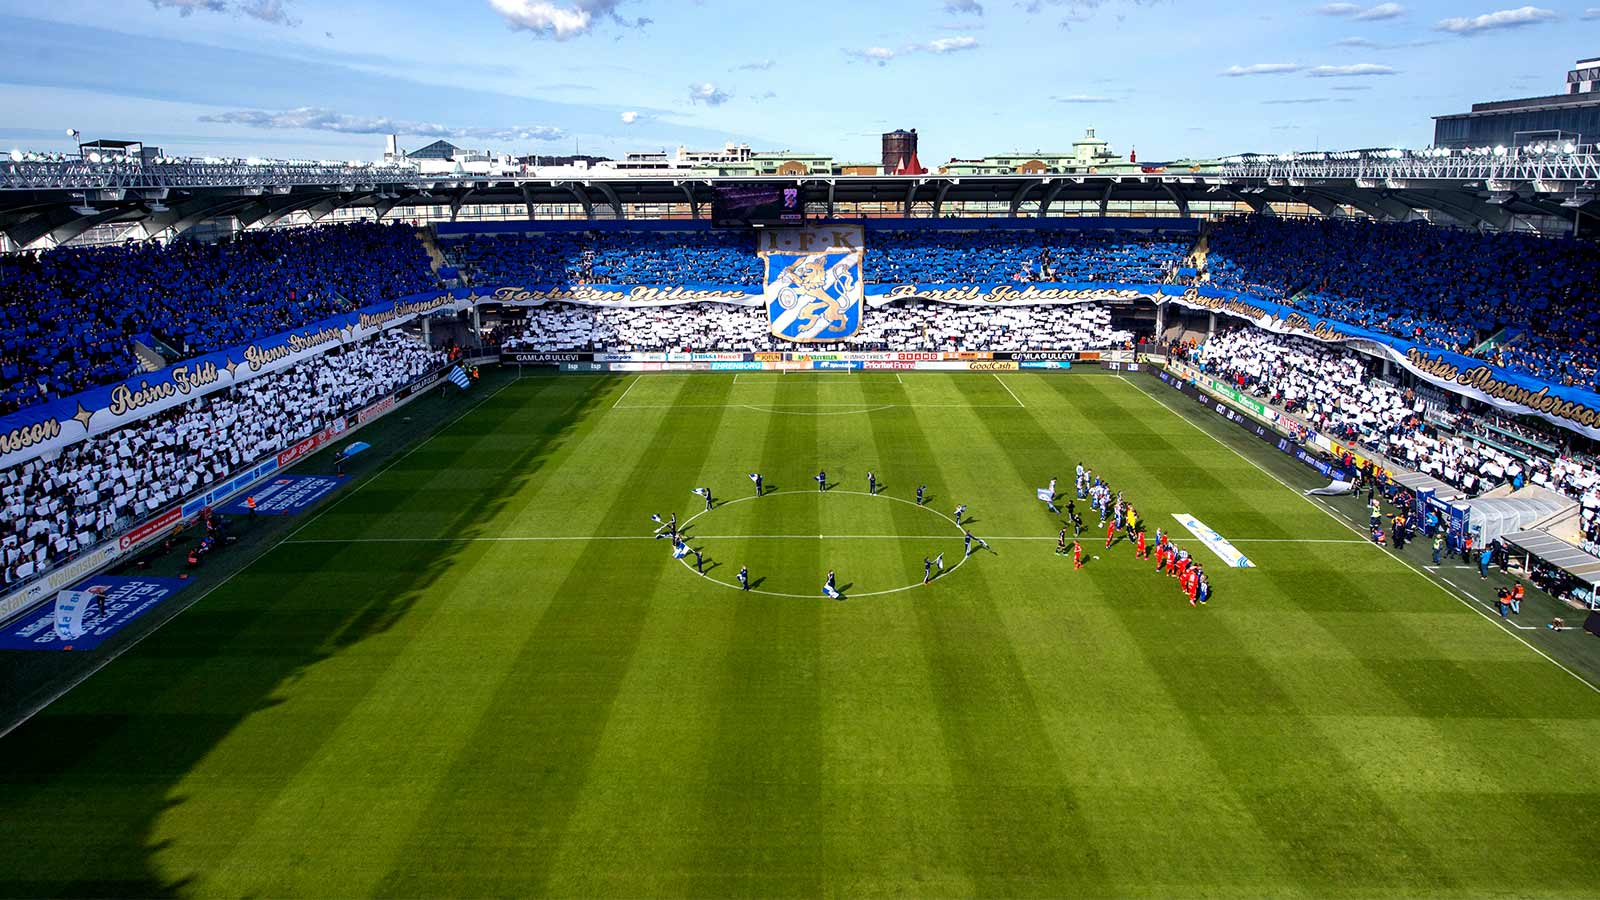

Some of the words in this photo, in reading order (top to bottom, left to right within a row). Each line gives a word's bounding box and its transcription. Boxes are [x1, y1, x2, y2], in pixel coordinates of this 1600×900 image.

[630, 285, 746, 302] Nilsson
[884, 284, 979, 301] Bertil
[983, 285, 1141, 302] Johansson
[244, 341, 290, 371] Glenn
[1407, 347, 1459, 381] Niclas
[109, 381, 176, 416] Reine
[172, 360, 219, 395] Feldt
